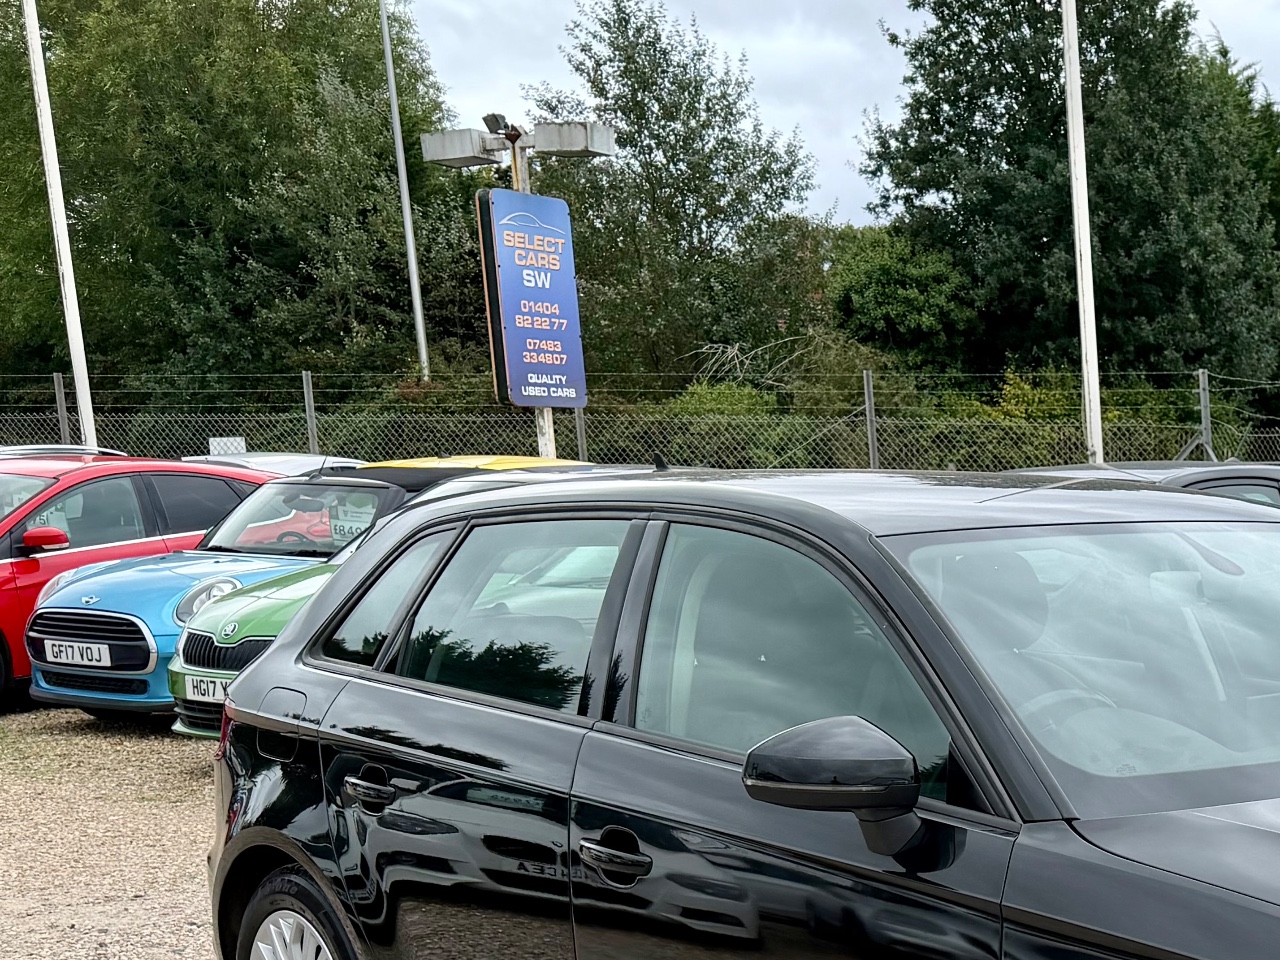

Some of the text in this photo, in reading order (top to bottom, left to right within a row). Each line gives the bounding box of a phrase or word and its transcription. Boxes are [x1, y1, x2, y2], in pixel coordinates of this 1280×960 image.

[503, 230, 565, 254] SELECT
[514, 249, 560, 271] CARS
[522, 269, 551, 289] SW
[520, 300, 560, 315] 01404
[526, 338, 562, 351] 07483
[522, 351, 567, 365] 334807
[527, 373, 567, 384] QUALITY
[521, 386, 576, 398] USED CARS
[333, 524, 368, 537] £849
[51, 643, 102, 663] GF17 VOJ
[191, 677, 217, 698] HG17
